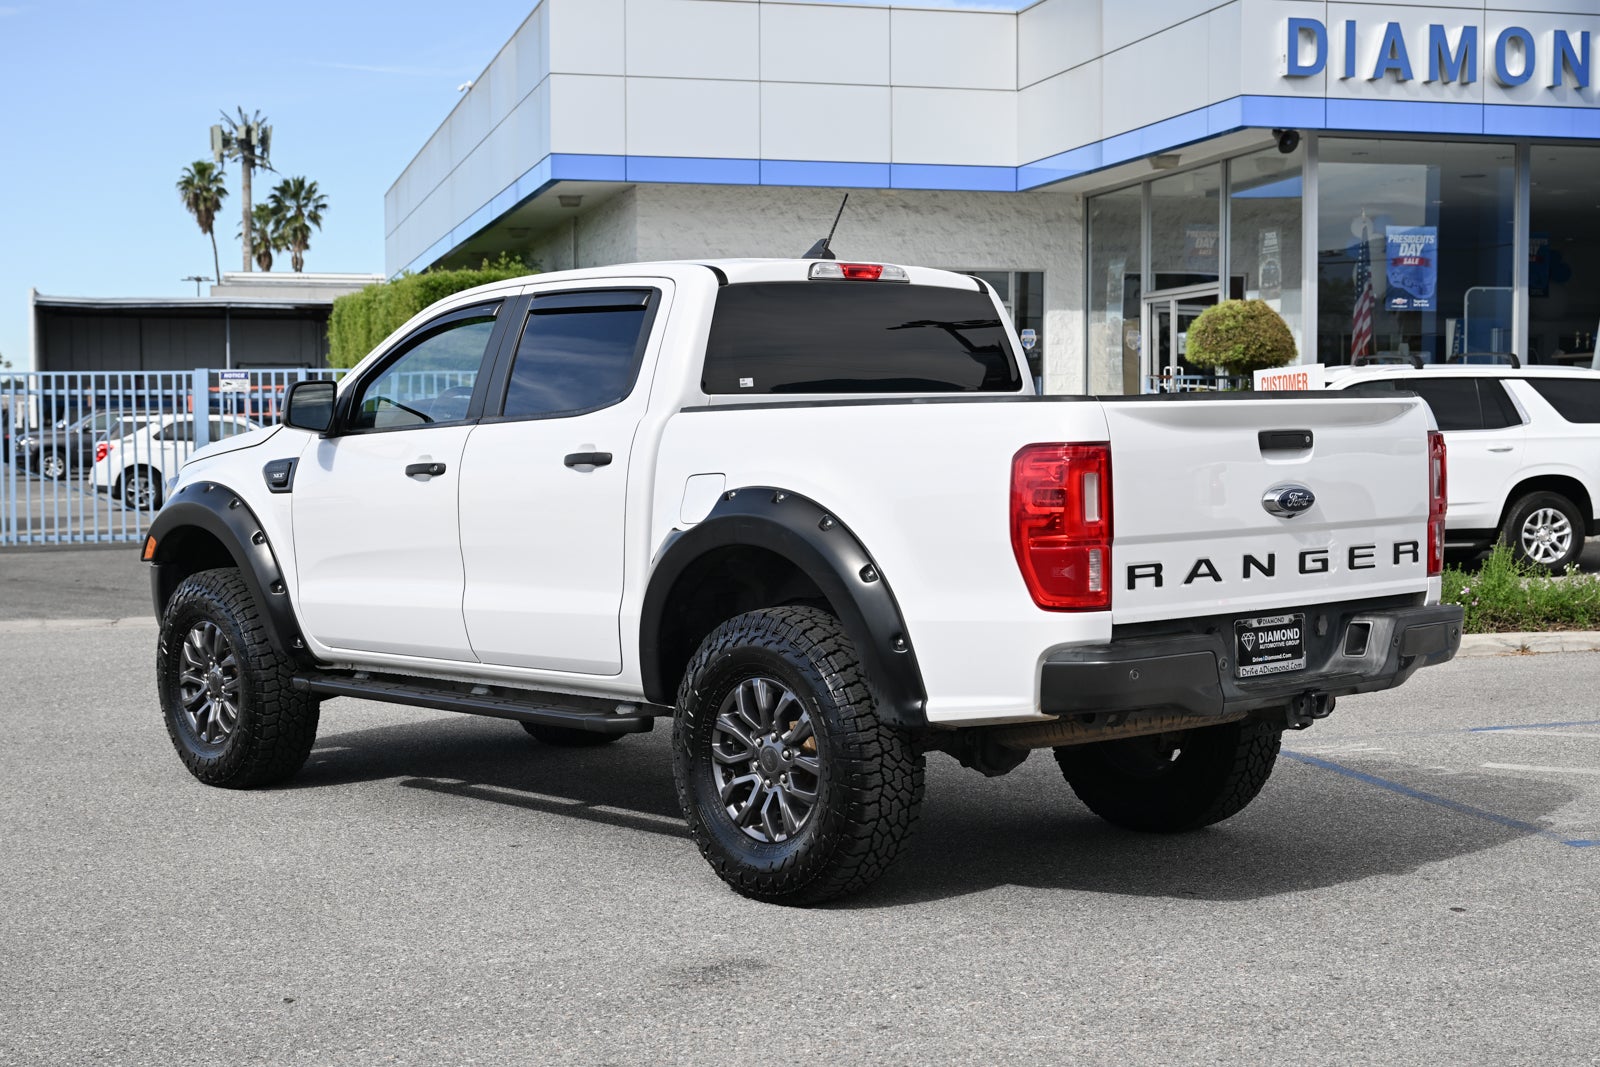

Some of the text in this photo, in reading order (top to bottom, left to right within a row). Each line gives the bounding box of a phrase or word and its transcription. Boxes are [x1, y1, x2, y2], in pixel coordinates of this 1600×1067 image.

[1288, 17, 1600, 88] DIAMON
[1388, 234, 1435, 244] PRESIDENTS
[1399, 243, 1424, 256] DAY
[1261, 372, 1309, 391] CUSTOMER
[1287, 492, 1309, 507] Ford
[1127, 540, 1419, 590] RANGER
[1262, 617, 1285, 625] DIAMOND
[1258, 628, 1300, 643] DIAMOND
